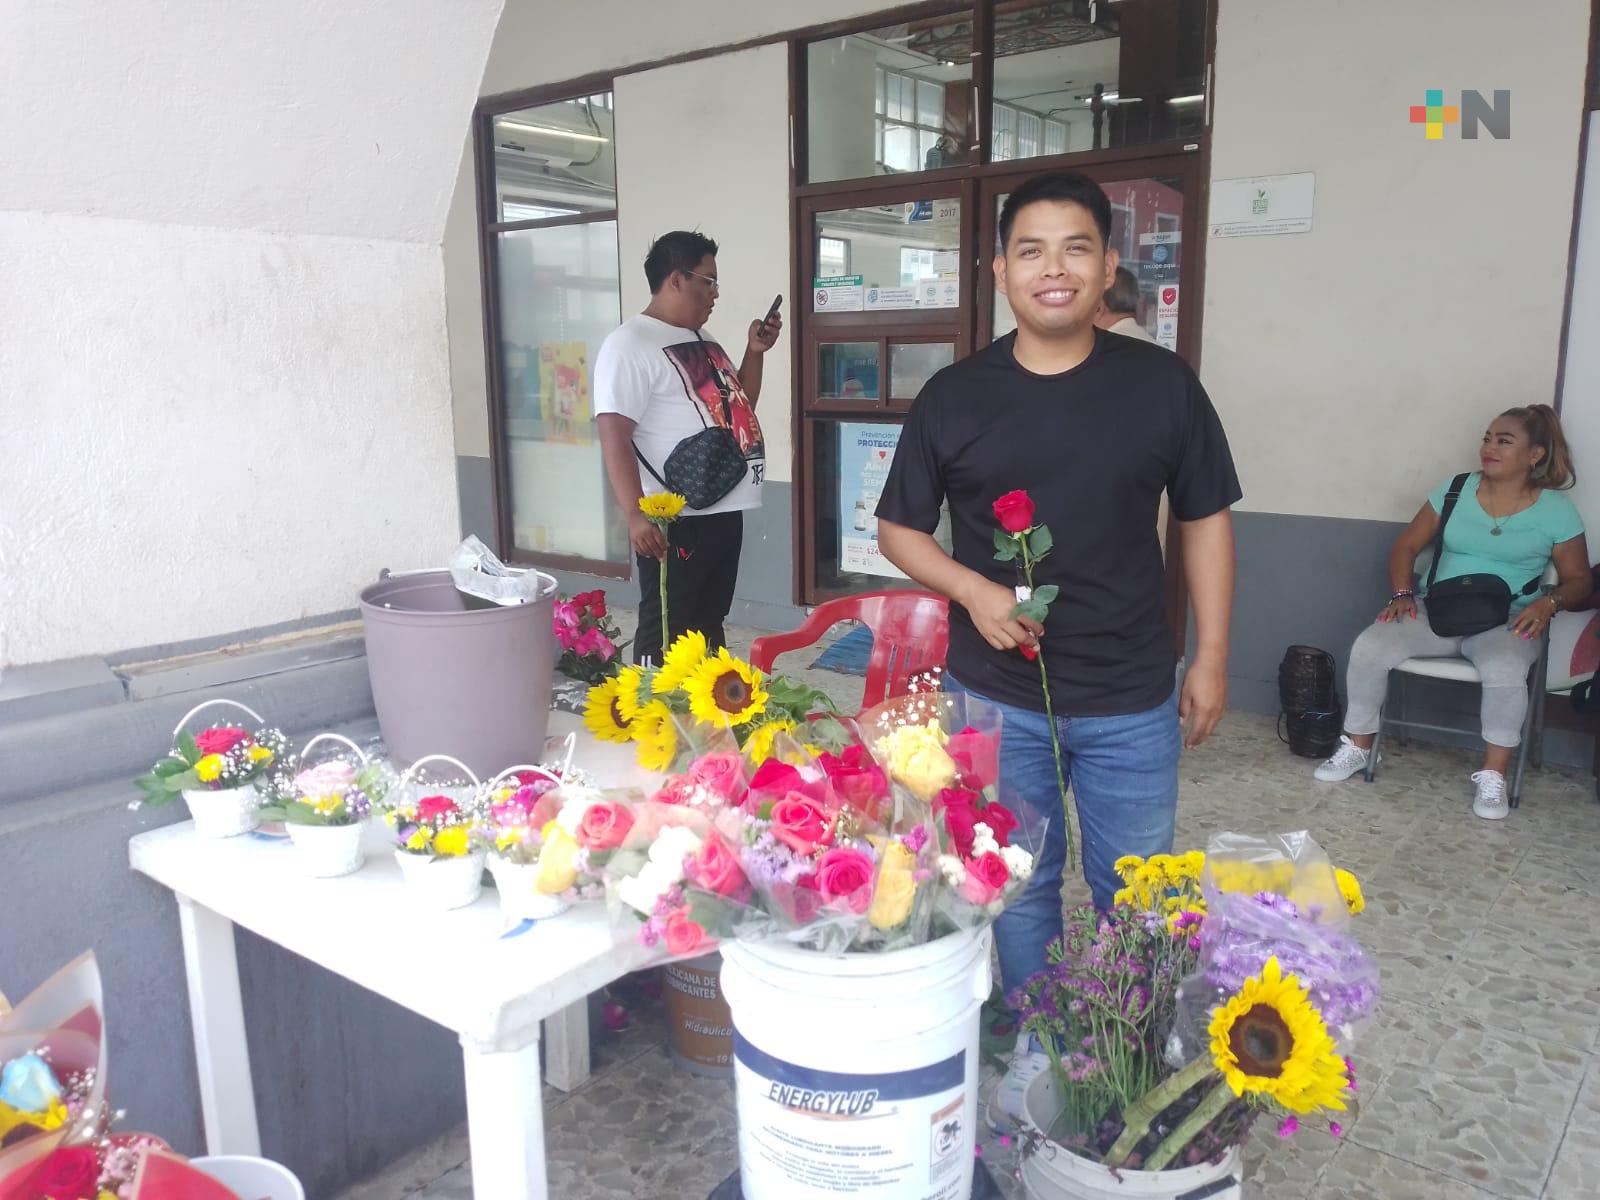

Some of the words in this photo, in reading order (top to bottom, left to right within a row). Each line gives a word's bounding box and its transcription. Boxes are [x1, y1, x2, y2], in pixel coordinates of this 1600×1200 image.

[940, 208, 956, 217] 2017
[861, 431, 896, 439] Prevención
[858, 439, 896, 449] PROTECCI
[704, 976, 716, 987] DE
[768, 1082, 877, 1115] ENERGYLUB
